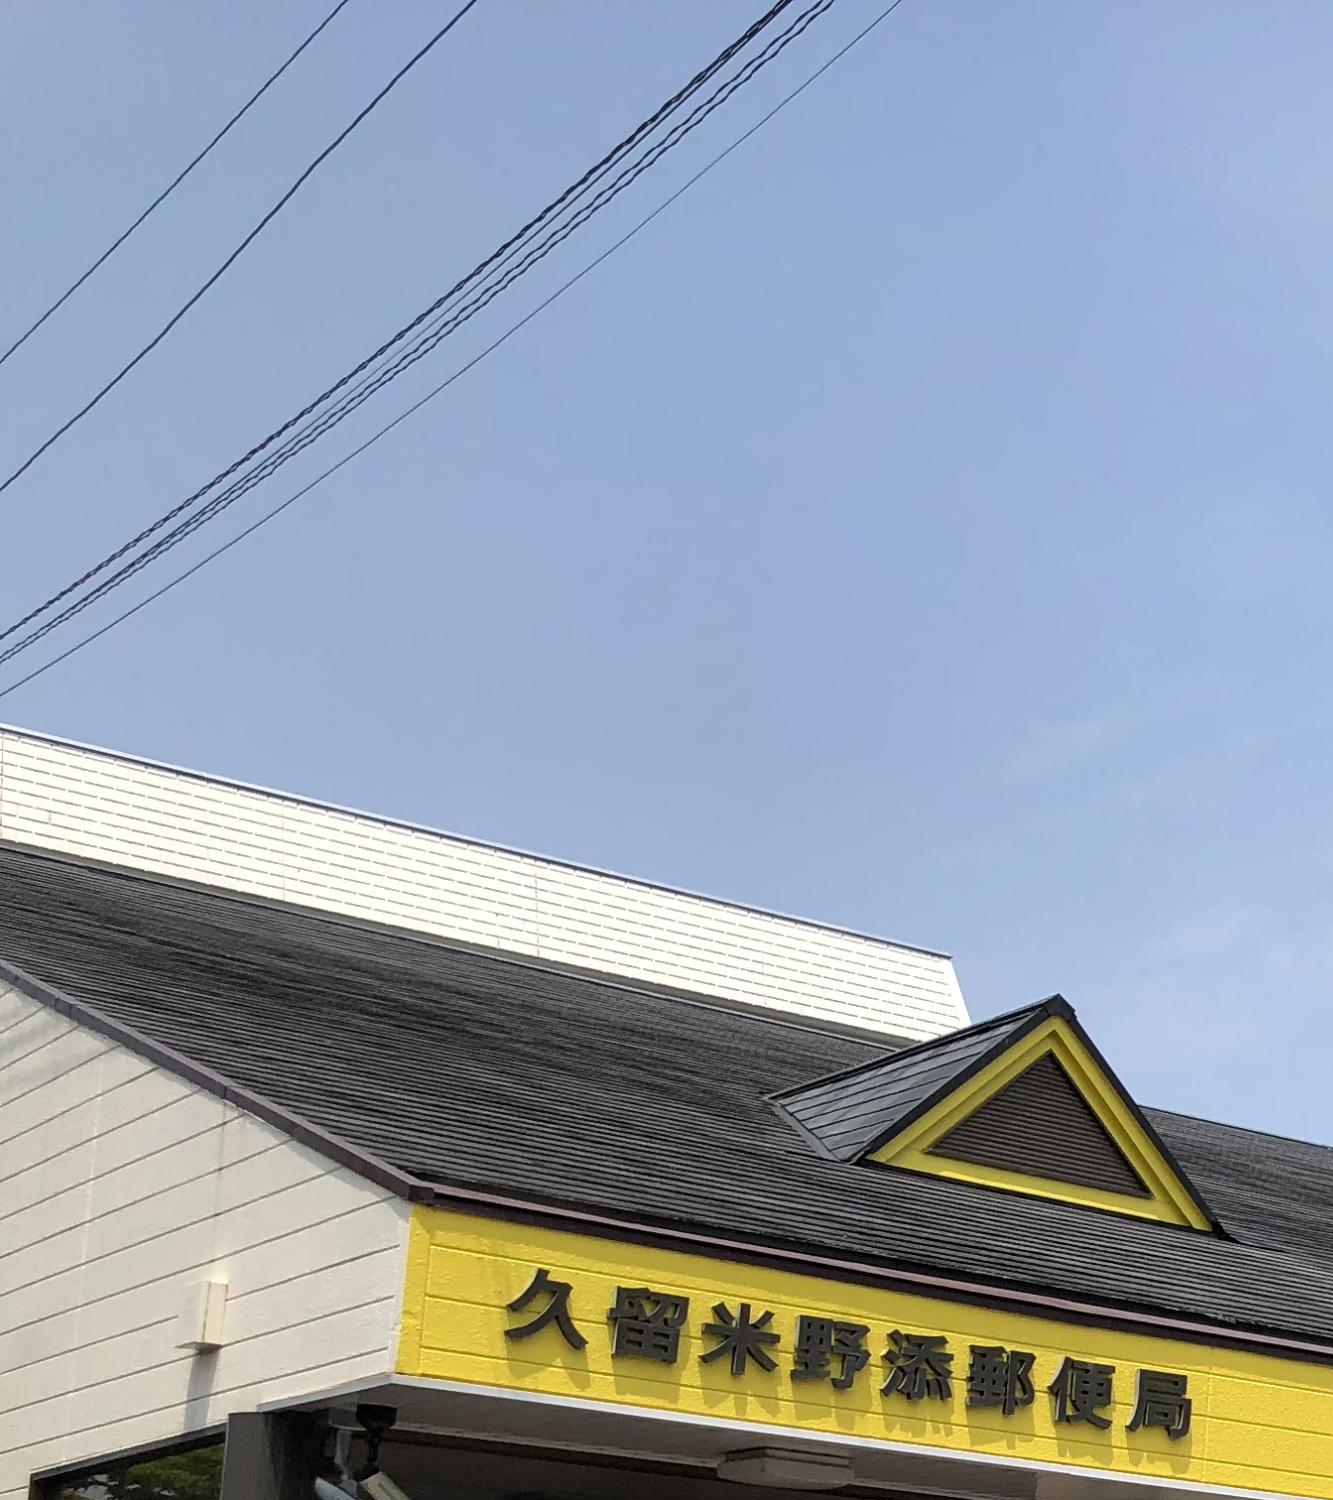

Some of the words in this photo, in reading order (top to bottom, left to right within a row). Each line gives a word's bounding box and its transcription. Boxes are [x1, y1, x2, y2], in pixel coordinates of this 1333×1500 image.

[505, 1268, 1192, 1442] 久留米野添郵便局
